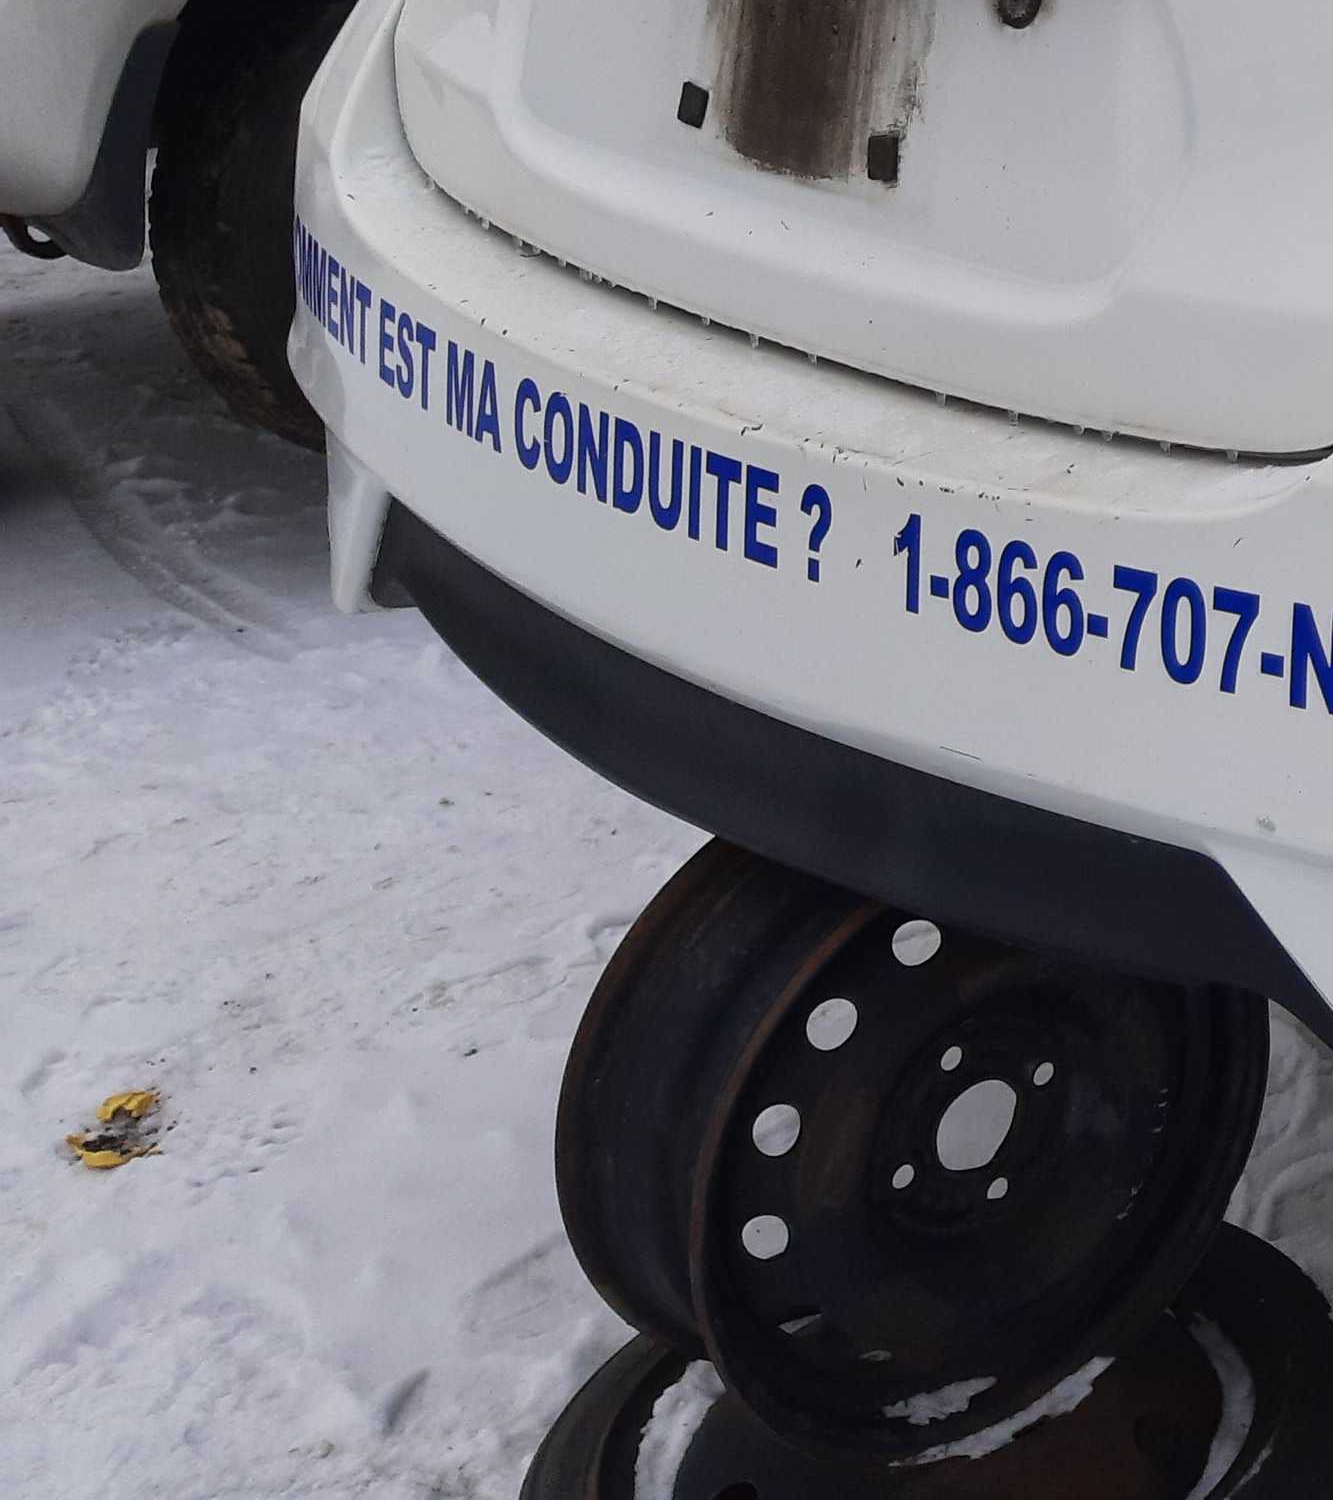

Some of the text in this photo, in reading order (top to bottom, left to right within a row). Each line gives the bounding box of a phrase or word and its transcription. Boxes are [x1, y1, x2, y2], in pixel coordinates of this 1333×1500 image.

[294, 214, 372, 365] OMMENT
[379, 298, 436, 410] EST
[446, 340, 501, 453] MA
[515, 377, 780, 569] CONDUITE
[800, 483, 832, 582] ?
